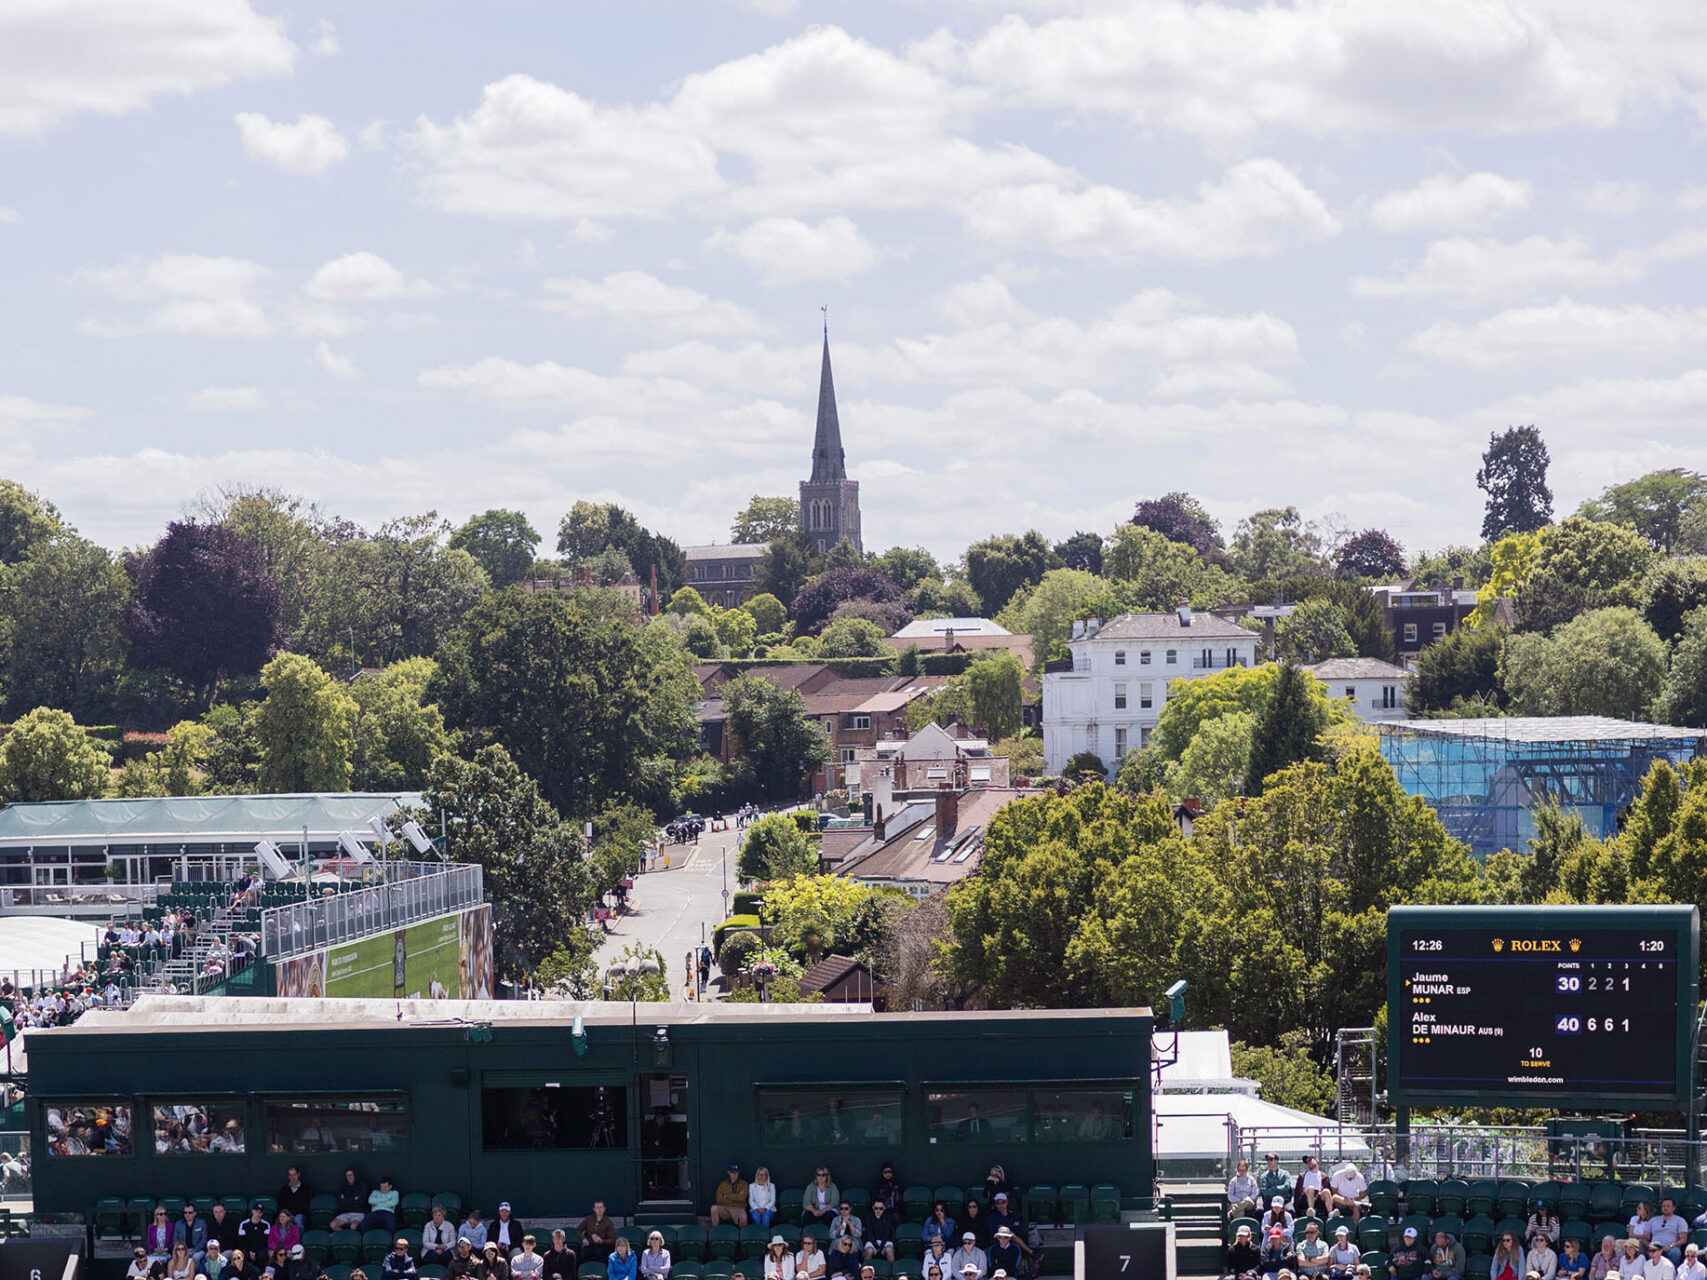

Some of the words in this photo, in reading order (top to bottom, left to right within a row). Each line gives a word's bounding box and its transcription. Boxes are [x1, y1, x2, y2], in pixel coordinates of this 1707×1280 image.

[1412, 940, 1443, 951] 12:26
[1511, 940, 1561, 952] ROLEX
[1640, 940, 1664, 952] 1:20
[1412, 972, 1448, 982] Jaume
[1412, 985, 1454, 994] MUNAR
[1558, 977, 1580, 991] 30
[1588, 977, 1597, 990] 2
[1605, 977, 1614, 990] 2
[1622, 977, 1630, 991] 1
[1412, 1012, 1436, 1022] Alex
[1412, 1025, 1428, 1034] DE
[1431, 1025, 1475, 1034] MINAUR
[1478, 1027, 1493, 1035] AUS
[1557, 1017, 1580, 1031] 40
[1587, 1018, 1597, 1031] 6
[1604, 1018, 1614, 1031] 6
[1622, 1018, 1629, 1032] 1
[1529, 1047, 1543, 1058] 10
[1119, 1255, 1131, 1272] 7
